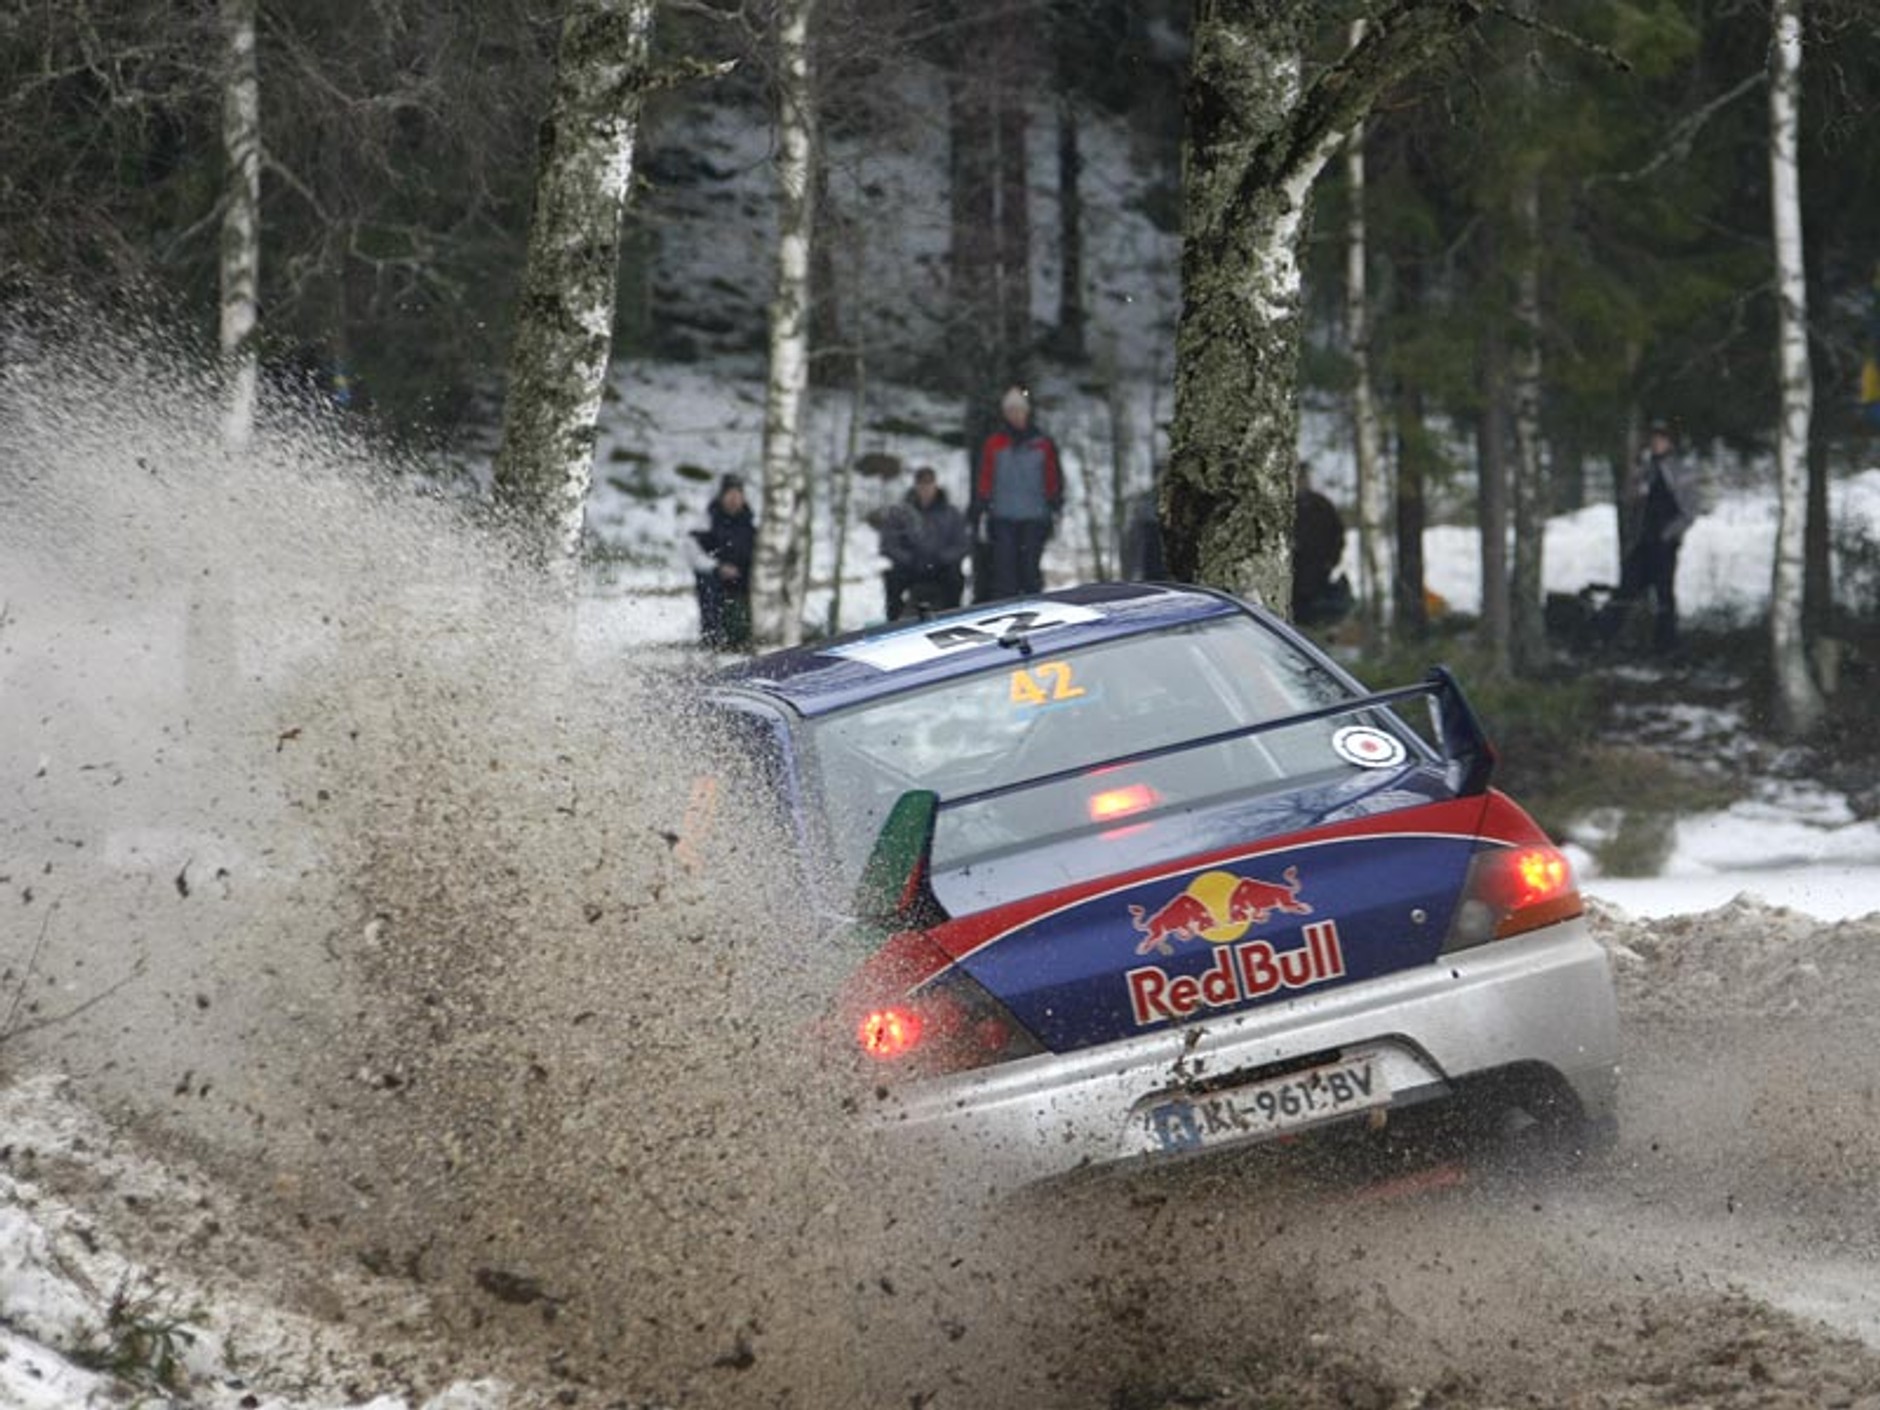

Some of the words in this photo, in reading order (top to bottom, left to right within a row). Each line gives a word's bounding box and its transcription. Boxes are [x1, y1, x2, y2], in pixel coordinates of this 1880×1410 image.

[1010, 660, 1085, 704] 42
[1127, 945, 1240, 1025] Red
[1236, 920, 1345, 999] Bull
